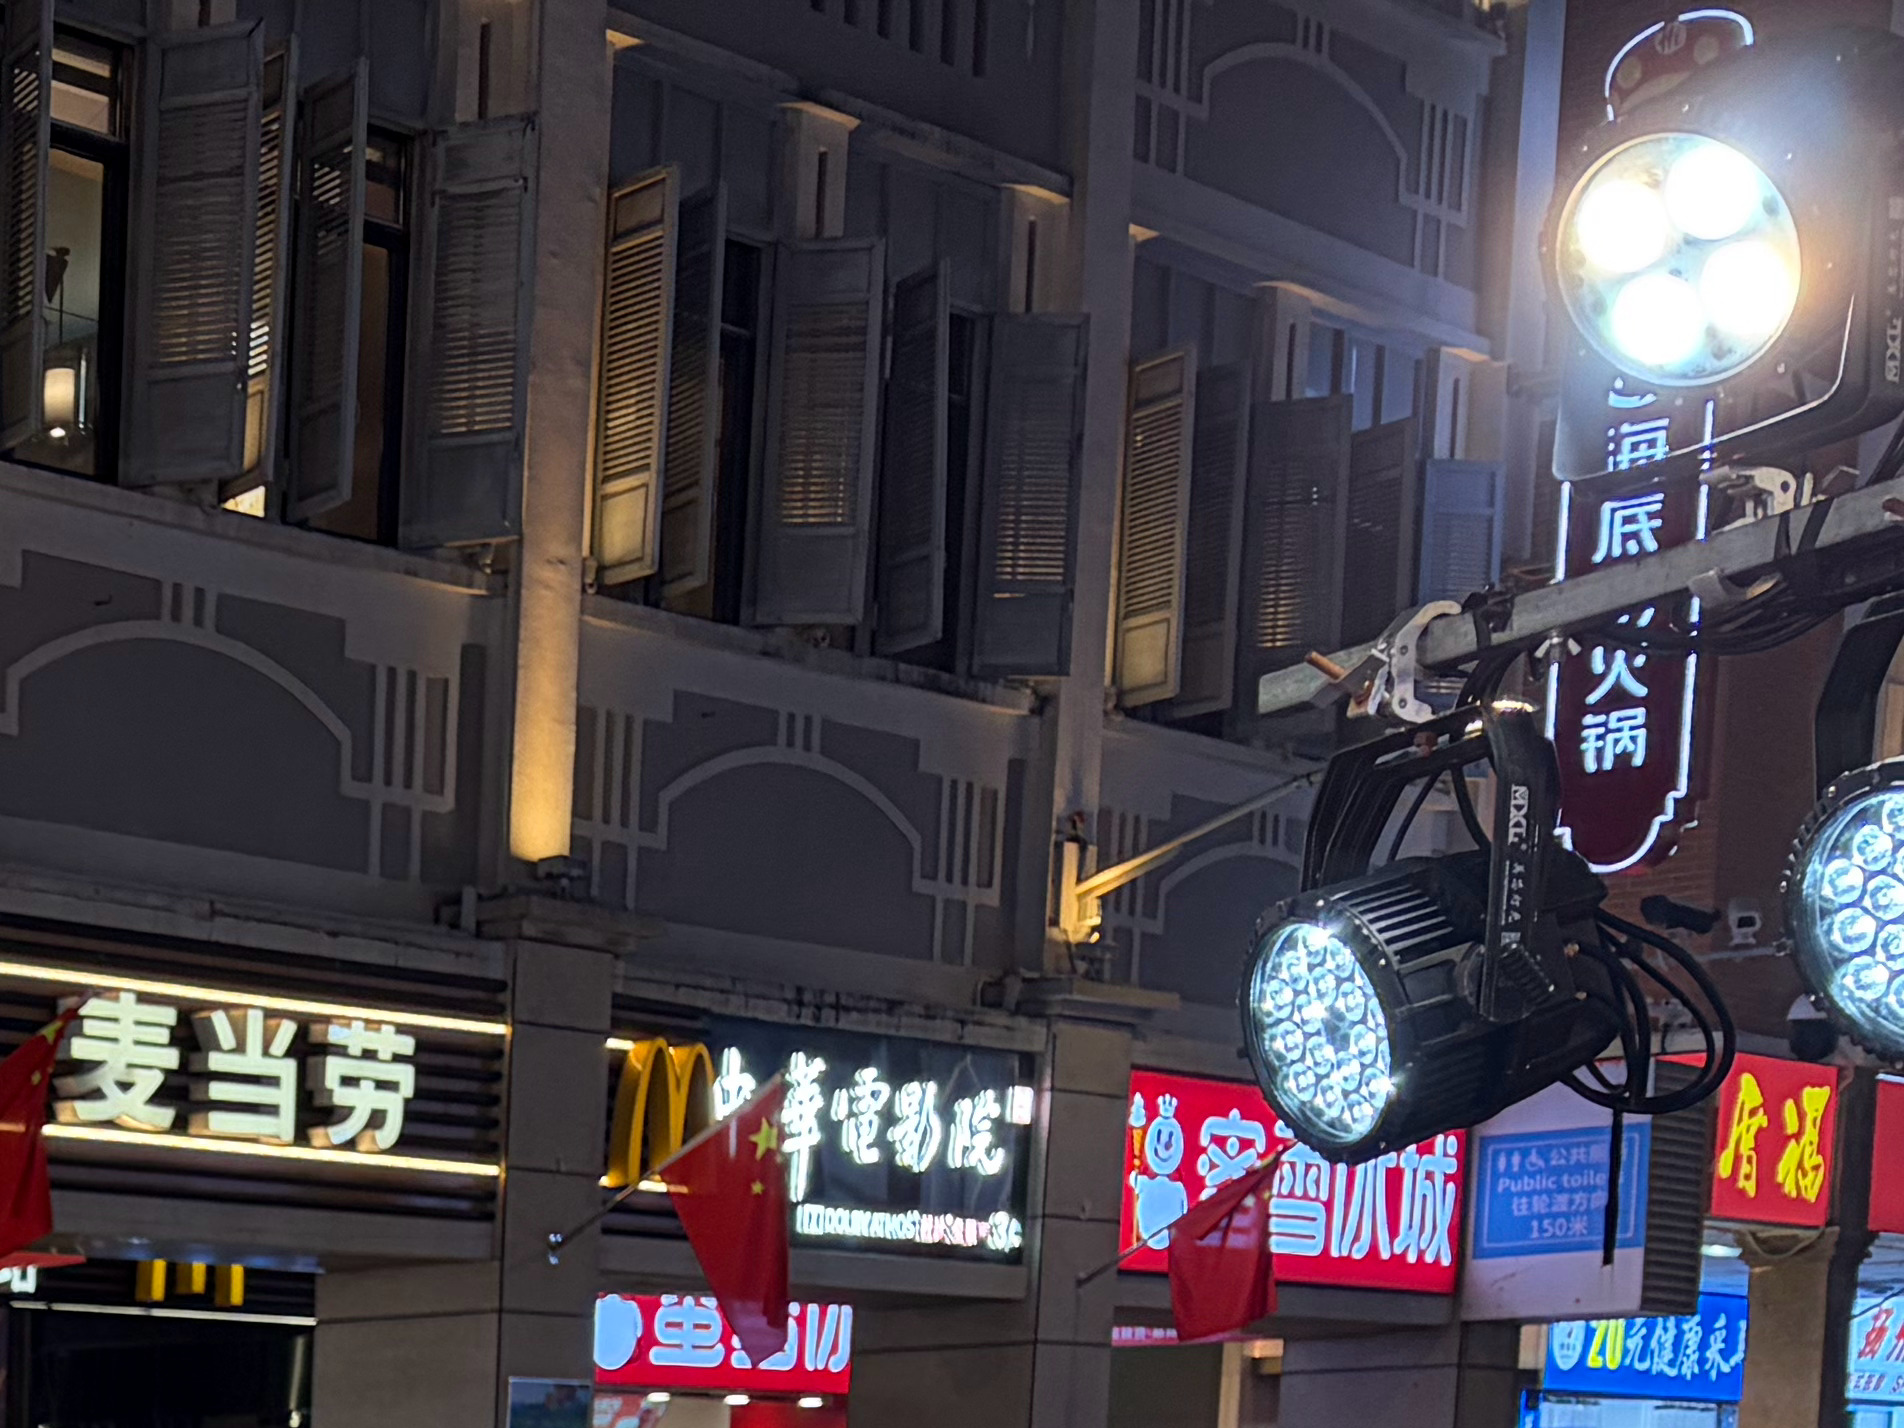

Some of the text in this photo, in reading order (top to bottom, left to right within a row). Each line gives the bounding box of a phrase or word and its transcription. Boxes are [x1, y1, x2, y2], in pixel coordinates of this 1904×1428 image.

[1580, 417, 1670, 774] 海底火锅
[64, 989, 417, 1152] 麦当劳
[1196, 1107, 1458, 1267] 蜜雪冰城
[1497, 1170, 1624, 1193] Public toile
[1549, 1142, 1628, 1167] 公共厕
[1531, 1215, 1589, 1239] 150米
